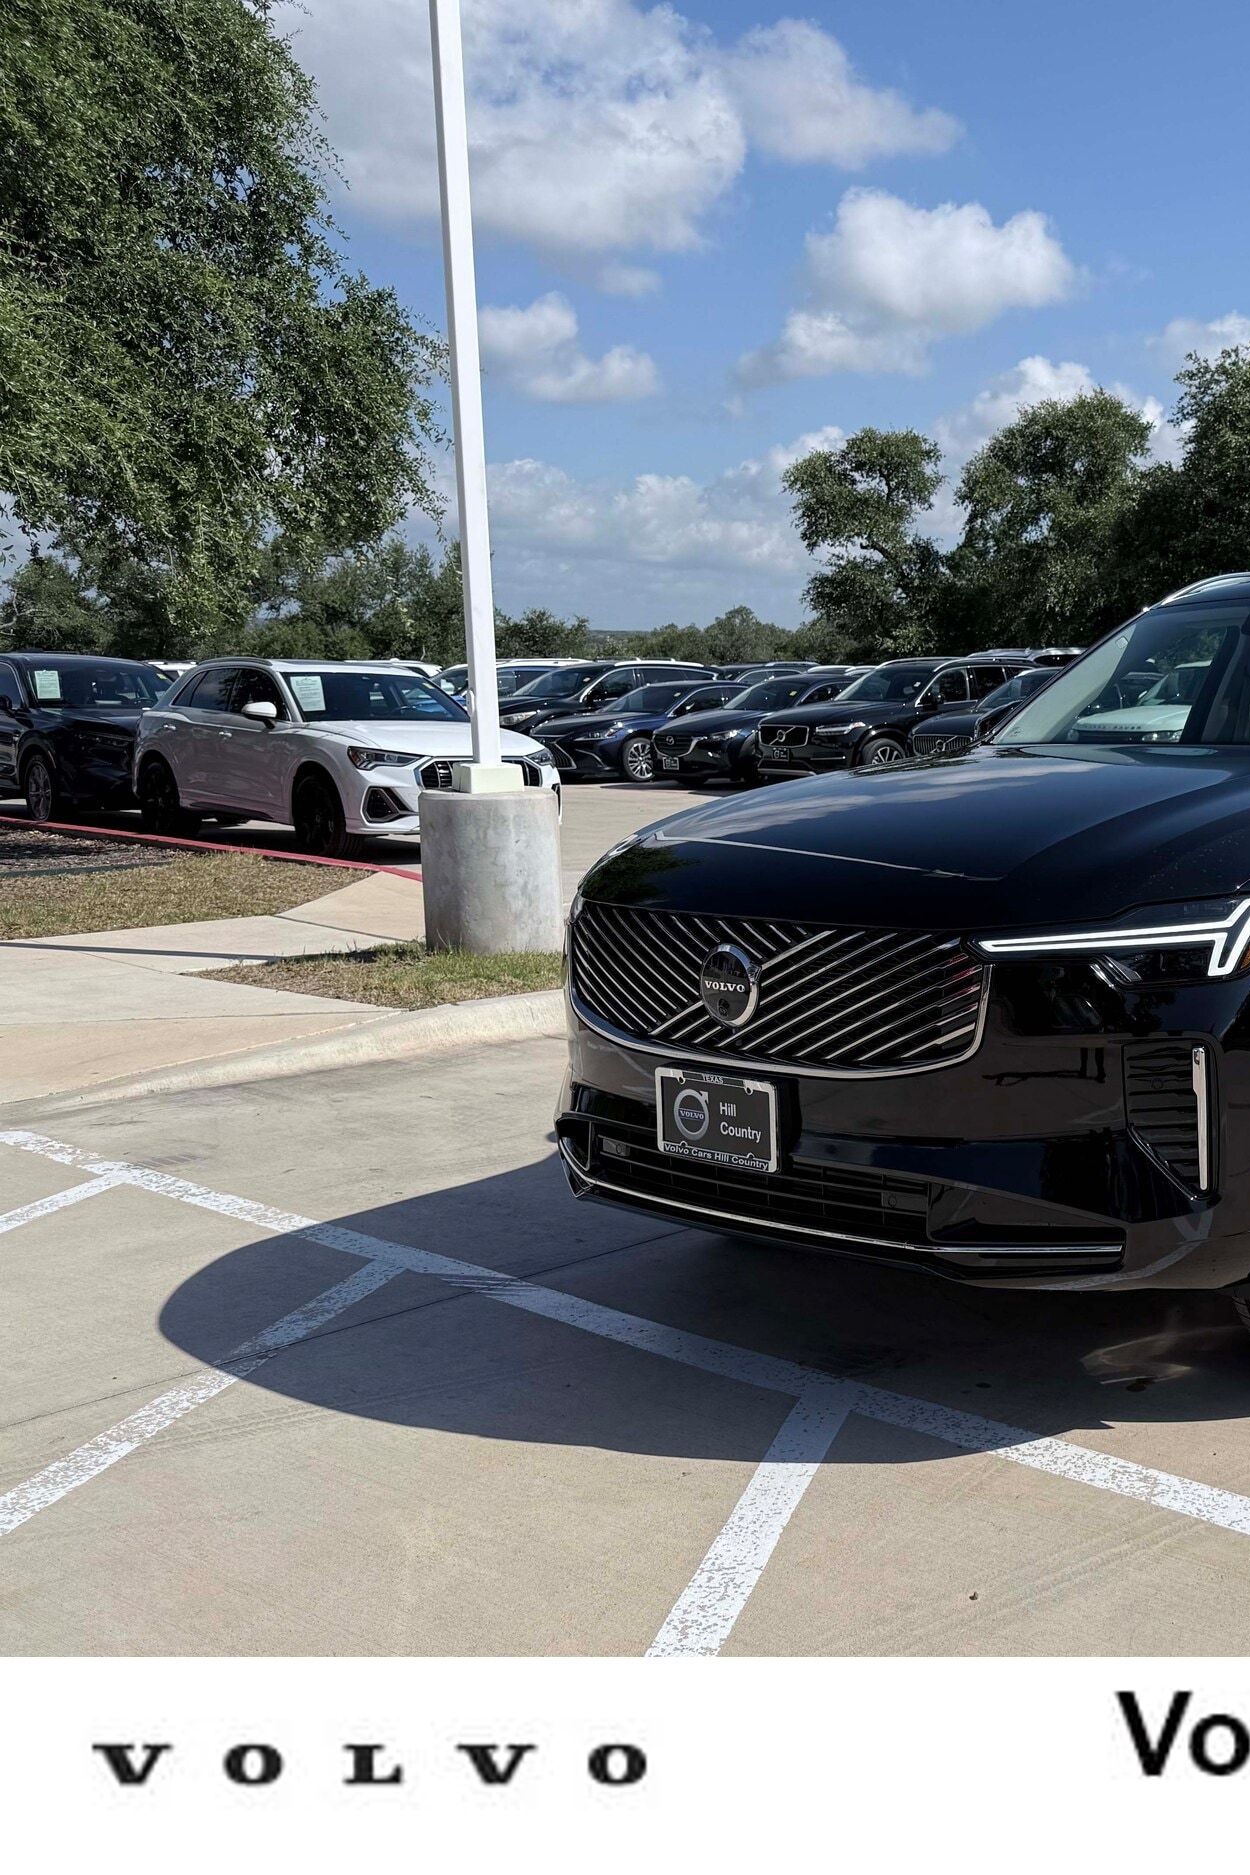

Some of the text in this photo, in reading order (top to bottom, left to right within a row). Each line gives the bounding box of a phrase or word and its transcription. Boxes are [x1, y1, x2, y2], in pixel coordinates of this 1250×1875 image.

[705, 980, 746, 993] VOLVO
[701, 1073, 724, 1085] TEXAS
[679, 1109, 705, 1120] VOLVO
[719, 1102, 737, 1117] Hill
[720, 1121, 762, 1143] Country
[664, 1143, 769, 1171] Volvo Cars Hill Country
